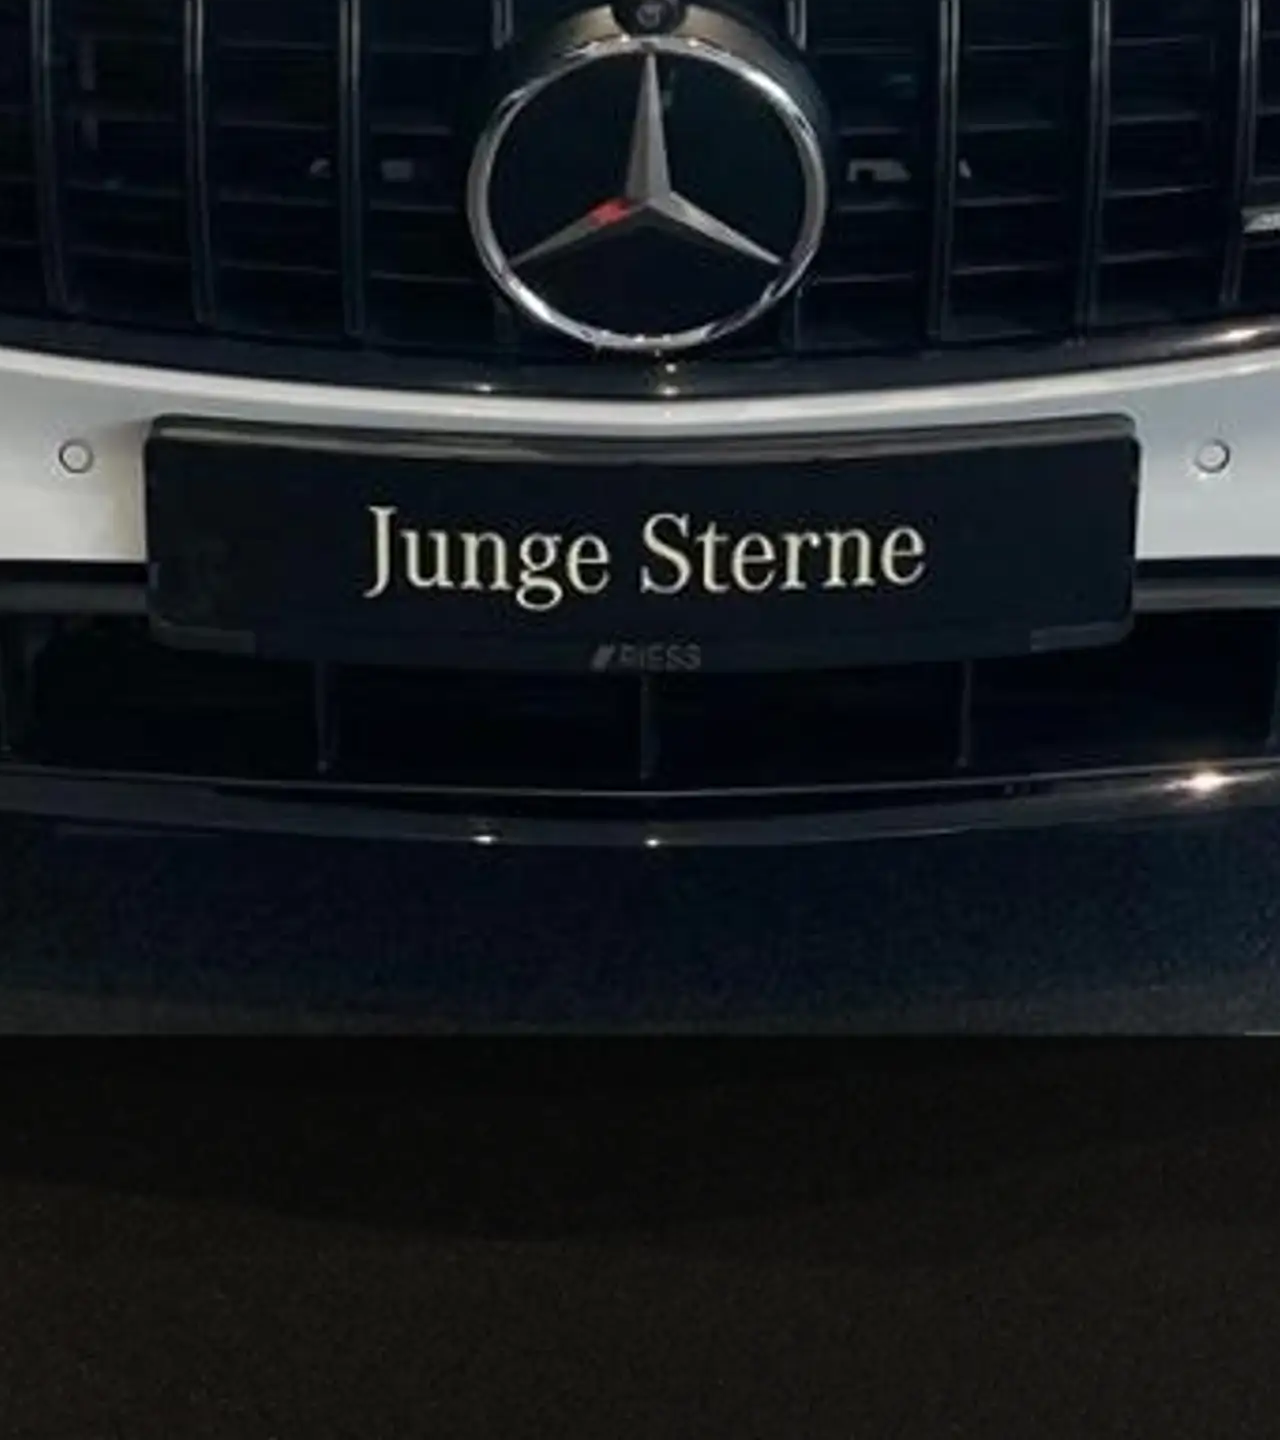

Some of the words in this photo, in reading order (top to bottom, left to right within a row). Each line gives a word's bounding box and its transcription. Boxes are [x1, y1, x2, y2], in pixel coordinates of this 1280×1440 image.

[363, 505, 611, 611] Junge
[639, 512, 926, 594] Sterne
[620, 643, 702, 672] RIESS
